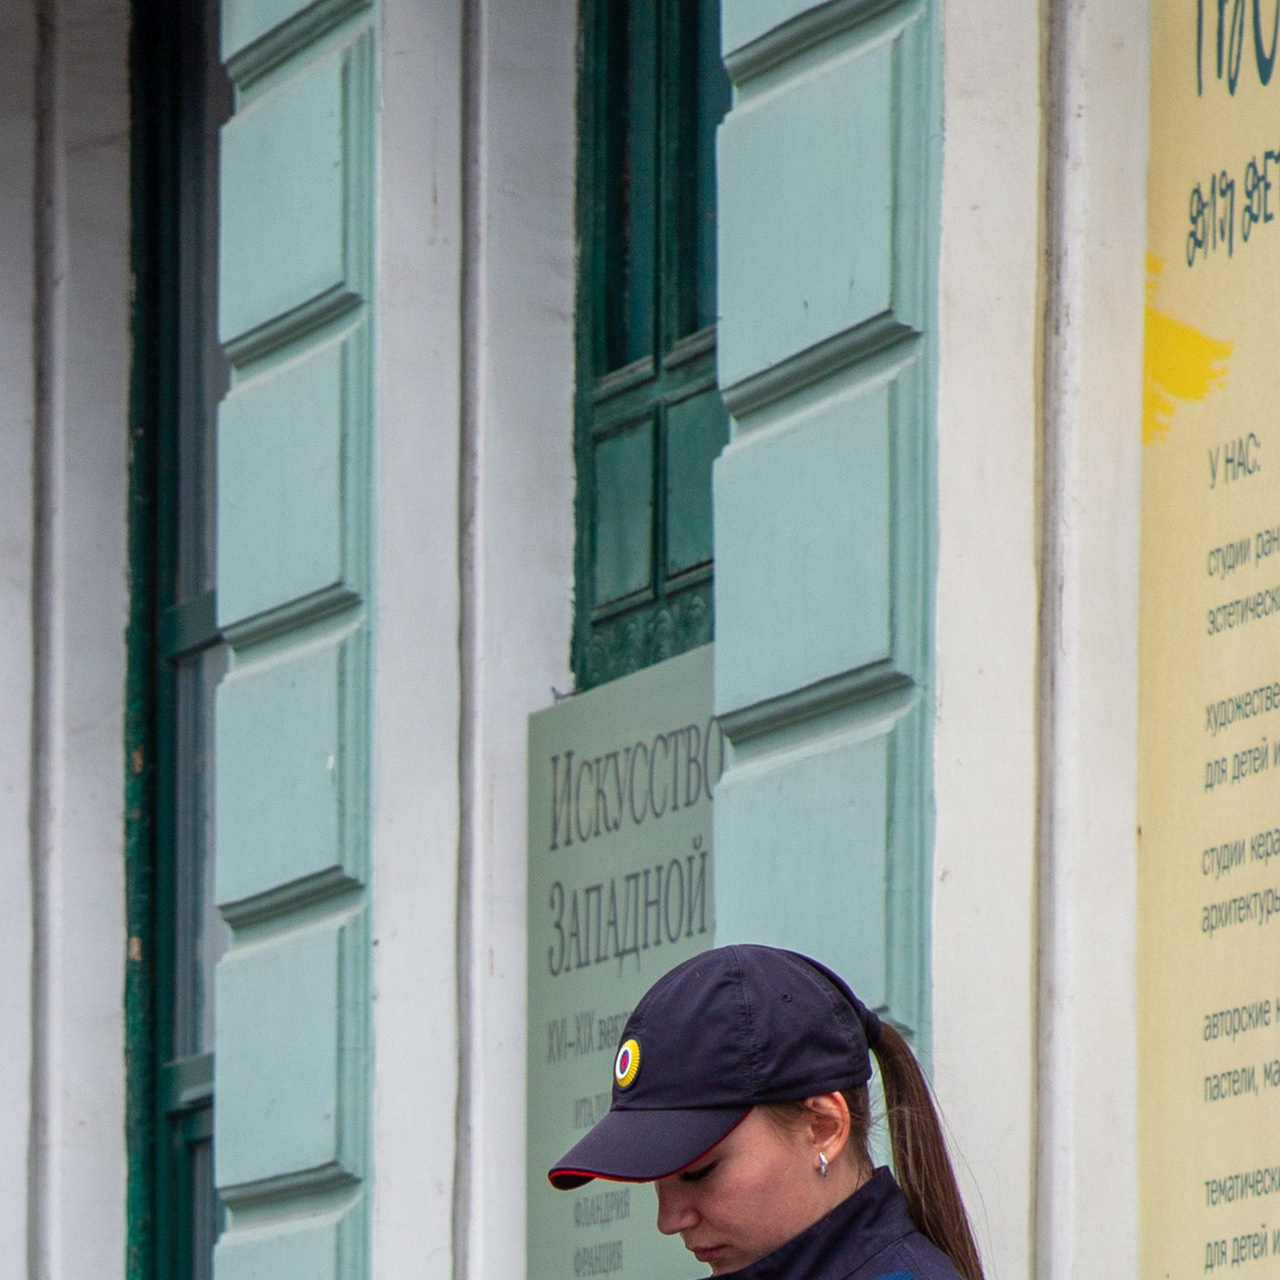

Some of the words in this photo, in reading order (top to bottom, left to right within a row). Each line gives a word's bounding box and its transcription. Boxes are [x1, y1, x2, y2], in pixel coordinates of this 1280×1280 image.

[1208, 537, 1251, 580] студии
[1205, 757, 1227, 795] для
[1232, 736, 1269, 786] детей
[1203, 838, 1246, 880] студии
[549, 834, 708, 977] ЗАПАДНОЙ
[1204, 999, 1271, 1042] авторские
[1204, 1065, 1259, 1102] пастели,
[1205, 1239, 1227, 1275] для
[1231, 1222, 1268, 1269] детей
